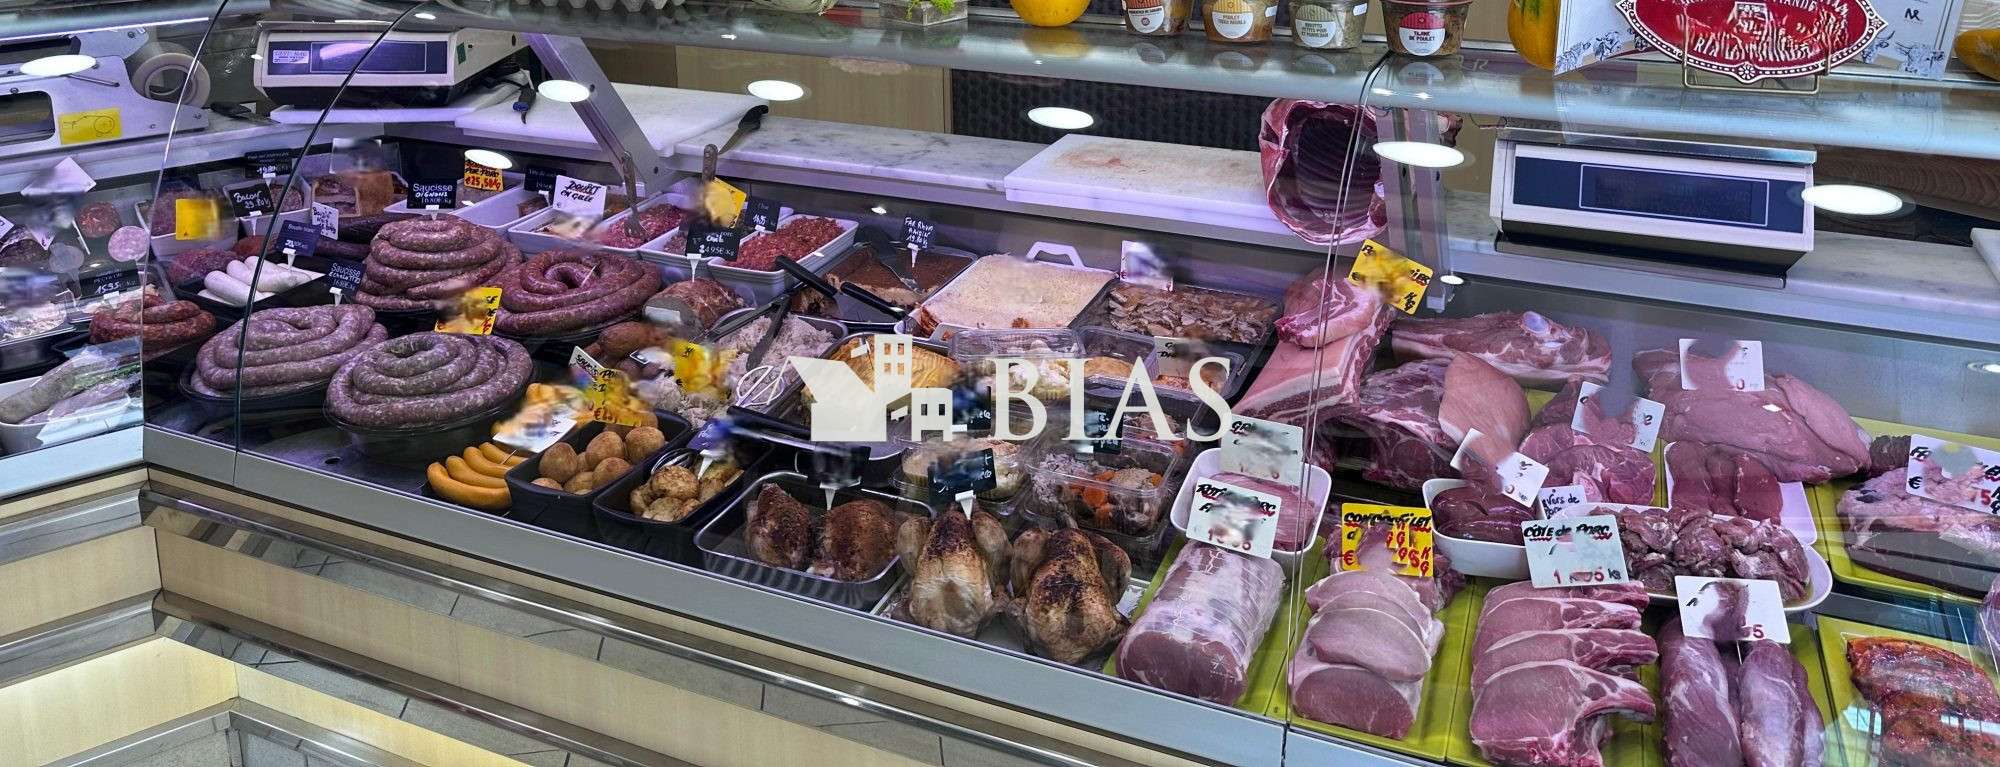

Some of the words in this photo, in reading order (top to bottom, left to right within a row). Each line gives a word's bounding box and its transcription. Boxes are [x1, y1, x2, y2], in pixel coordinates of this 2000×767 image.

[412, 183, 453, 192] Saucisse
[1908, 476, 1923, 489] €
[1343, 549, 1356, 566] €
